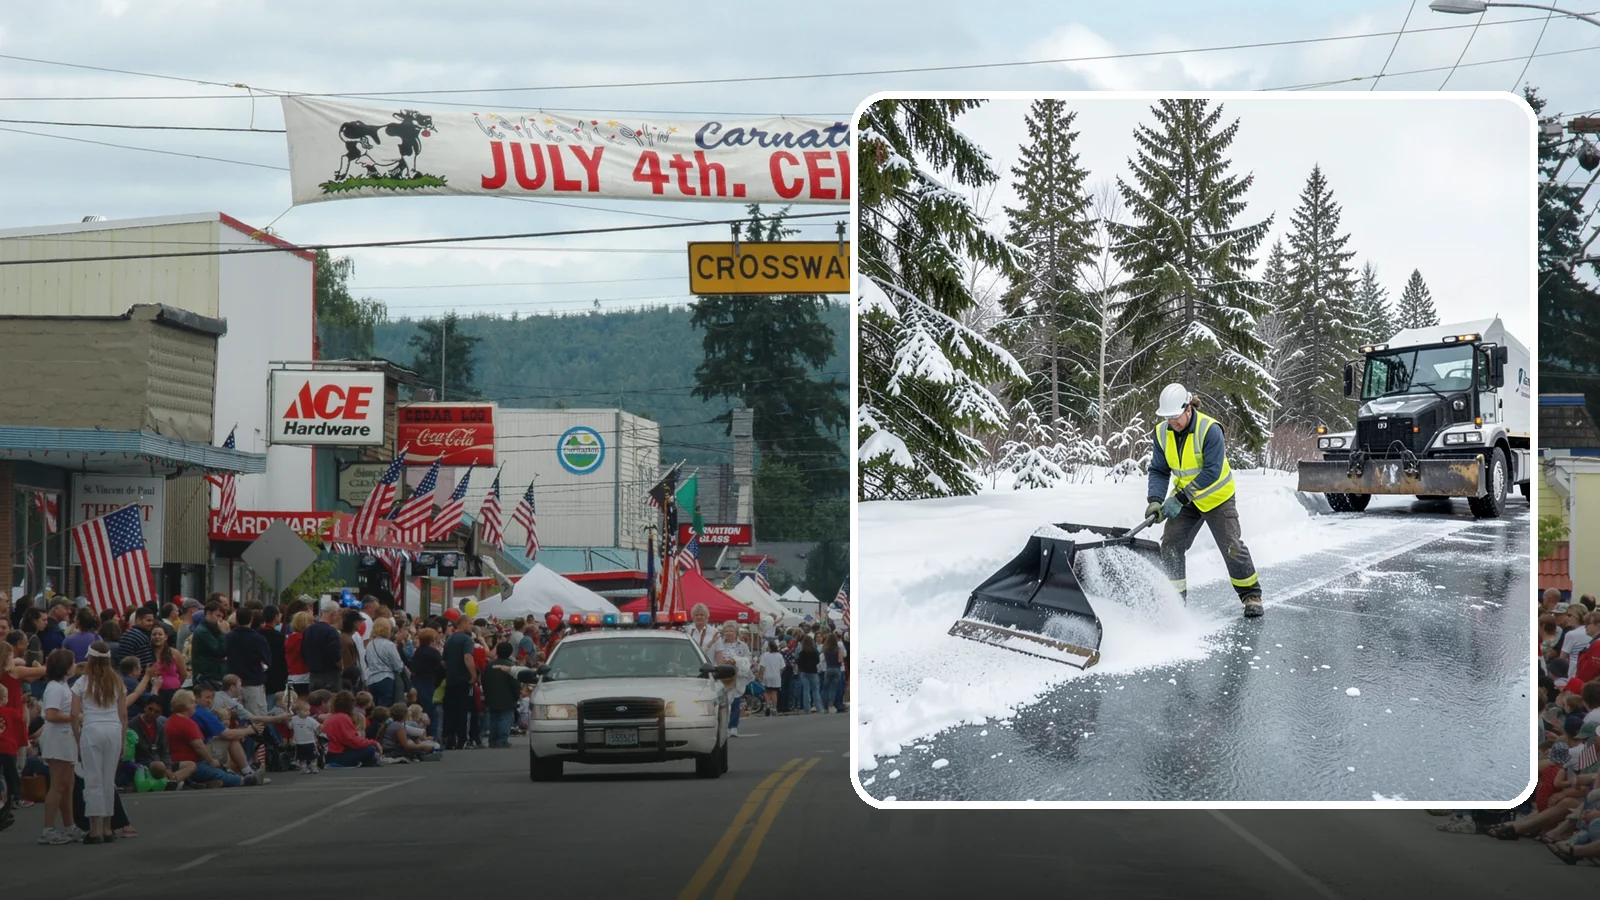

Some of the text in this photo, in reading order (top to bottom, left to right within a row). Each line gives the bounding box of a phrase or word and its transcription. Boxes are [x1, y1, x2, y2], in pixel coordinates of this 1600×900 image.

[481, 141, 604, 192] JULY
[632, 150, 746, 197] 4th.
[697, 254, 850, 280] CROSSWA
[283, 380, 373, 420] ACE
[405, 409, 485, 421] CEDAR LOG
[283, 421, 371, 436] Hardware
[416, 428, 476, 446] Coca-Cola
[353, 466, 387, 480] Simpl
[83, 484, 155, 495] St. Vincent de Paul
[212, 516, 331, 535] HARDARE
[688, 526, 742, 535] CRNATION
[699, 535, 730, 543] GLASS
